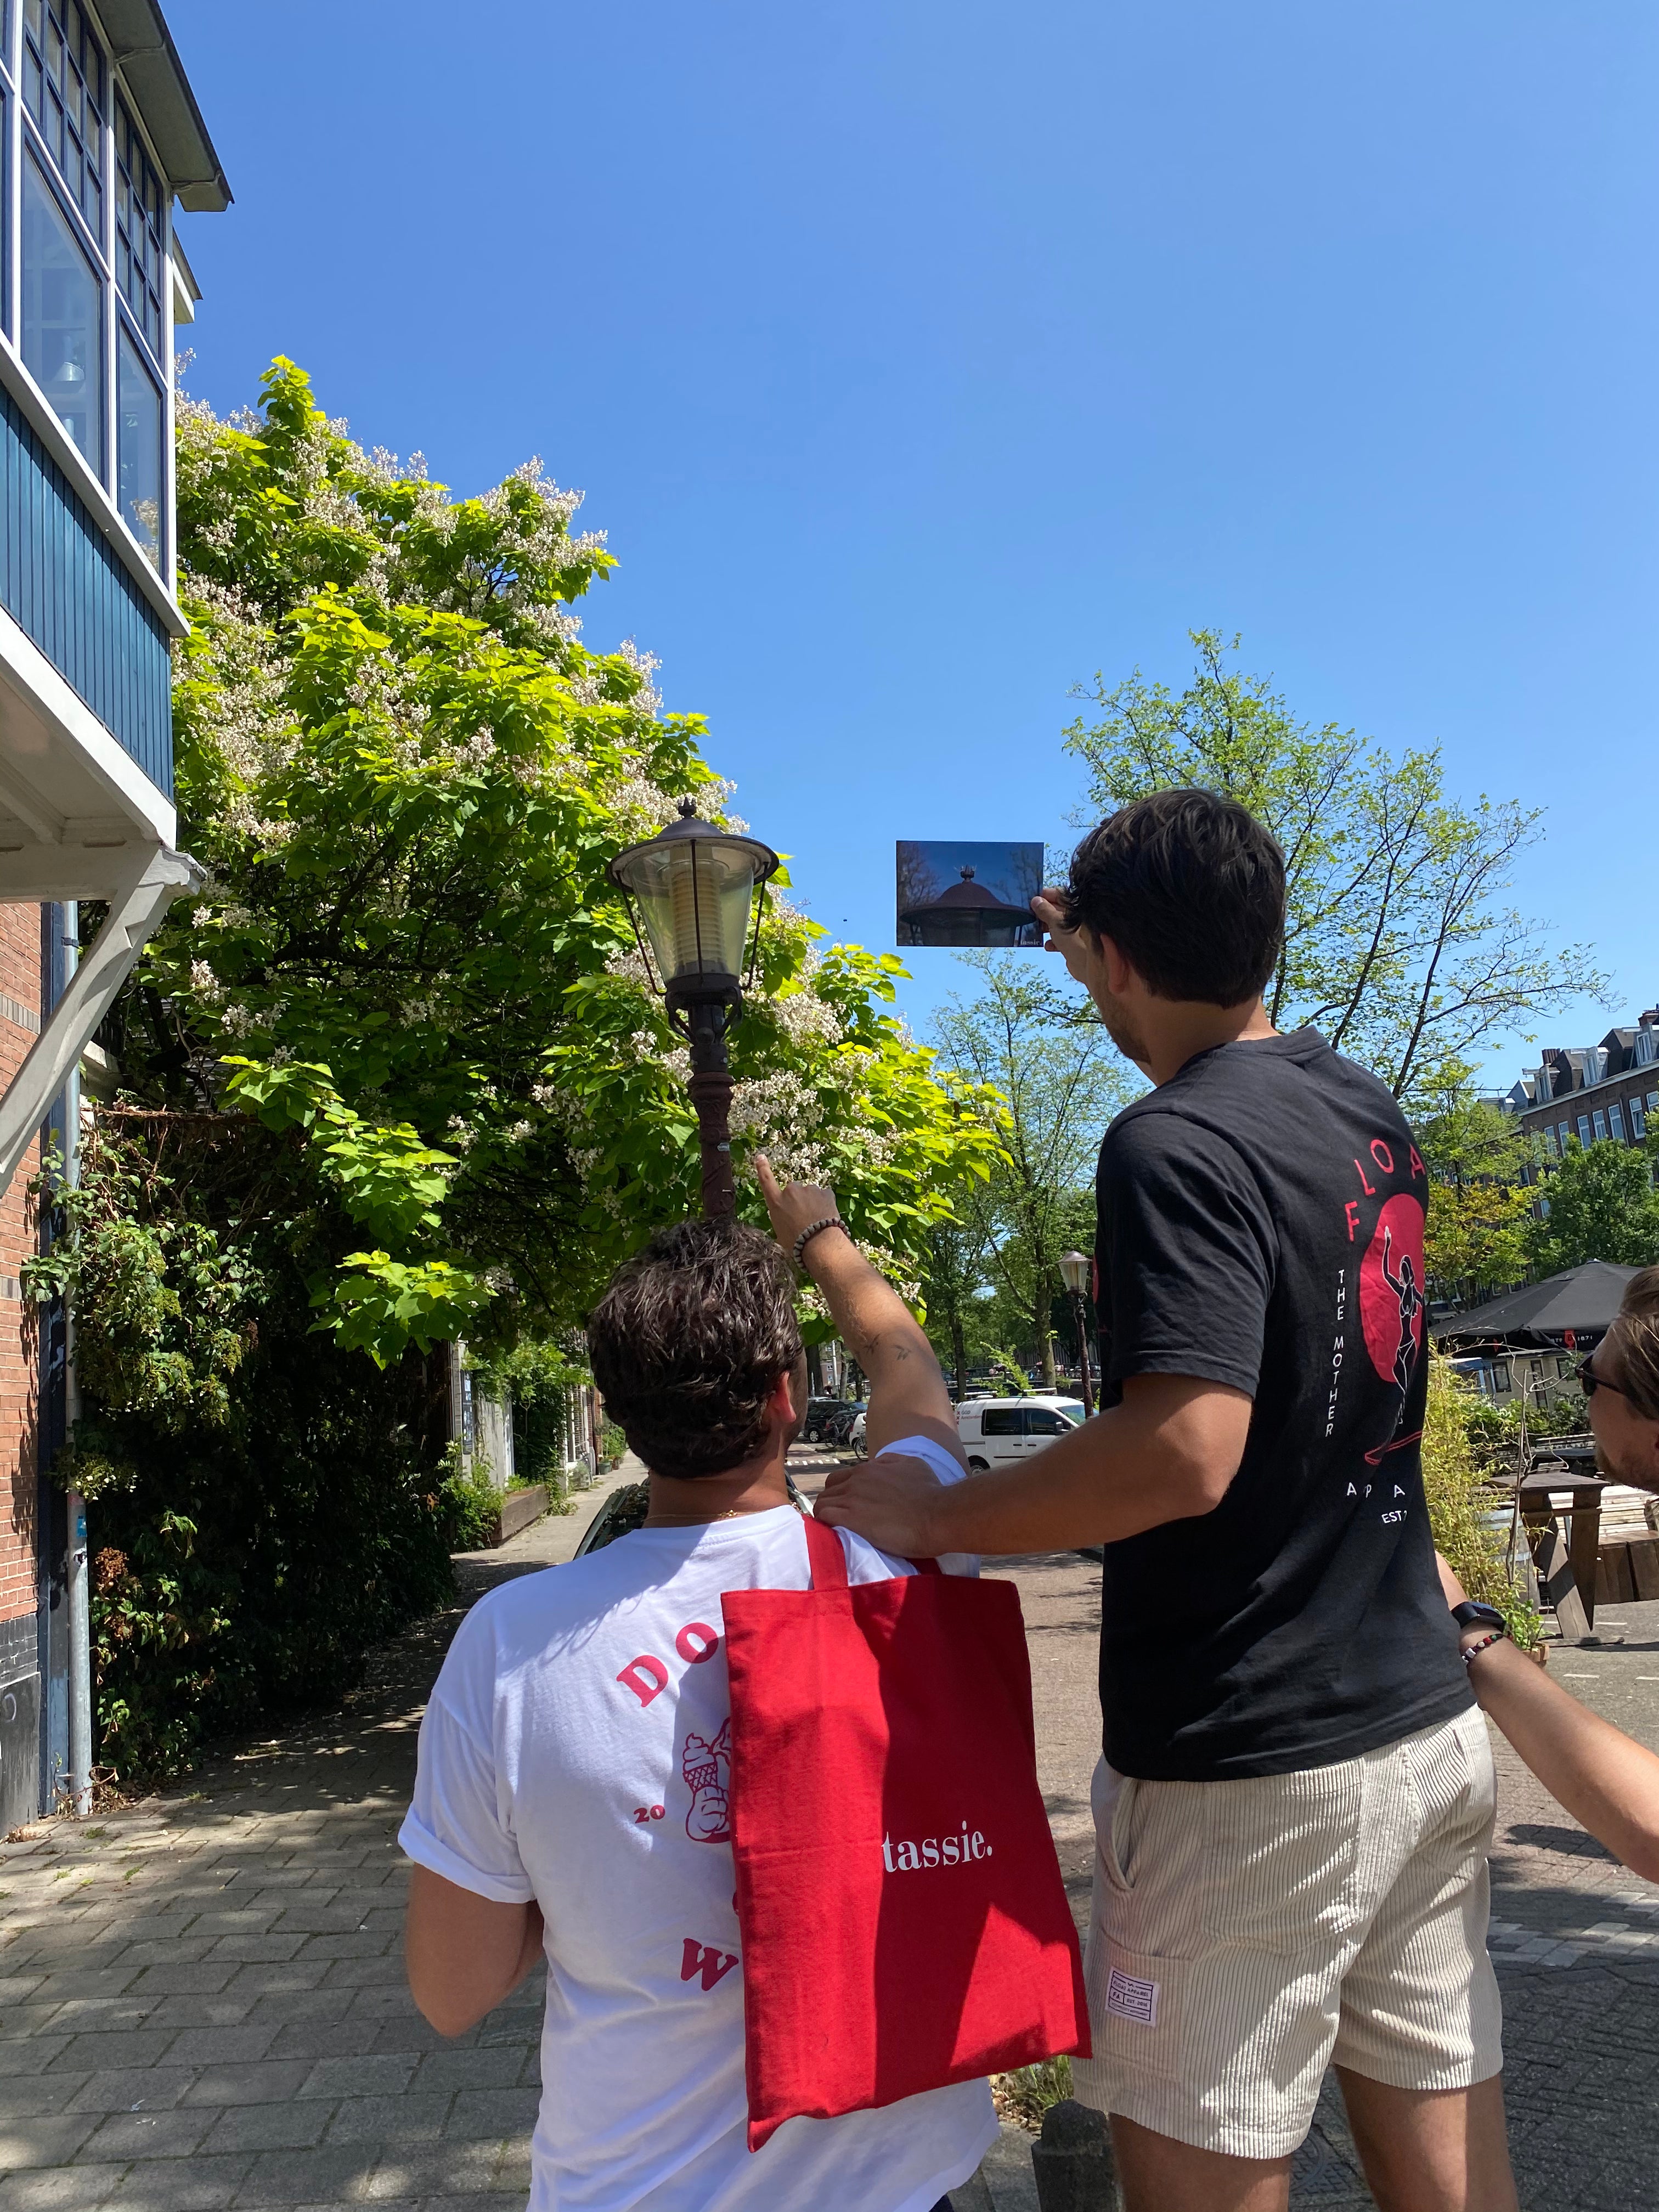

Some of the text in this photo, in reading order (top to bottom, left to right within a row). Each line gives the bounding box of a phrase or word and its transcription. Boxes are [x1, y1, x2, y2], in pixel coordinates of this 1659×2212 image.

[1325, 1269, 1346, 1438] THE MOTHER
[634, 1804, 665, 1824] 20
[881, 1820, 992, 1872] tassie.
